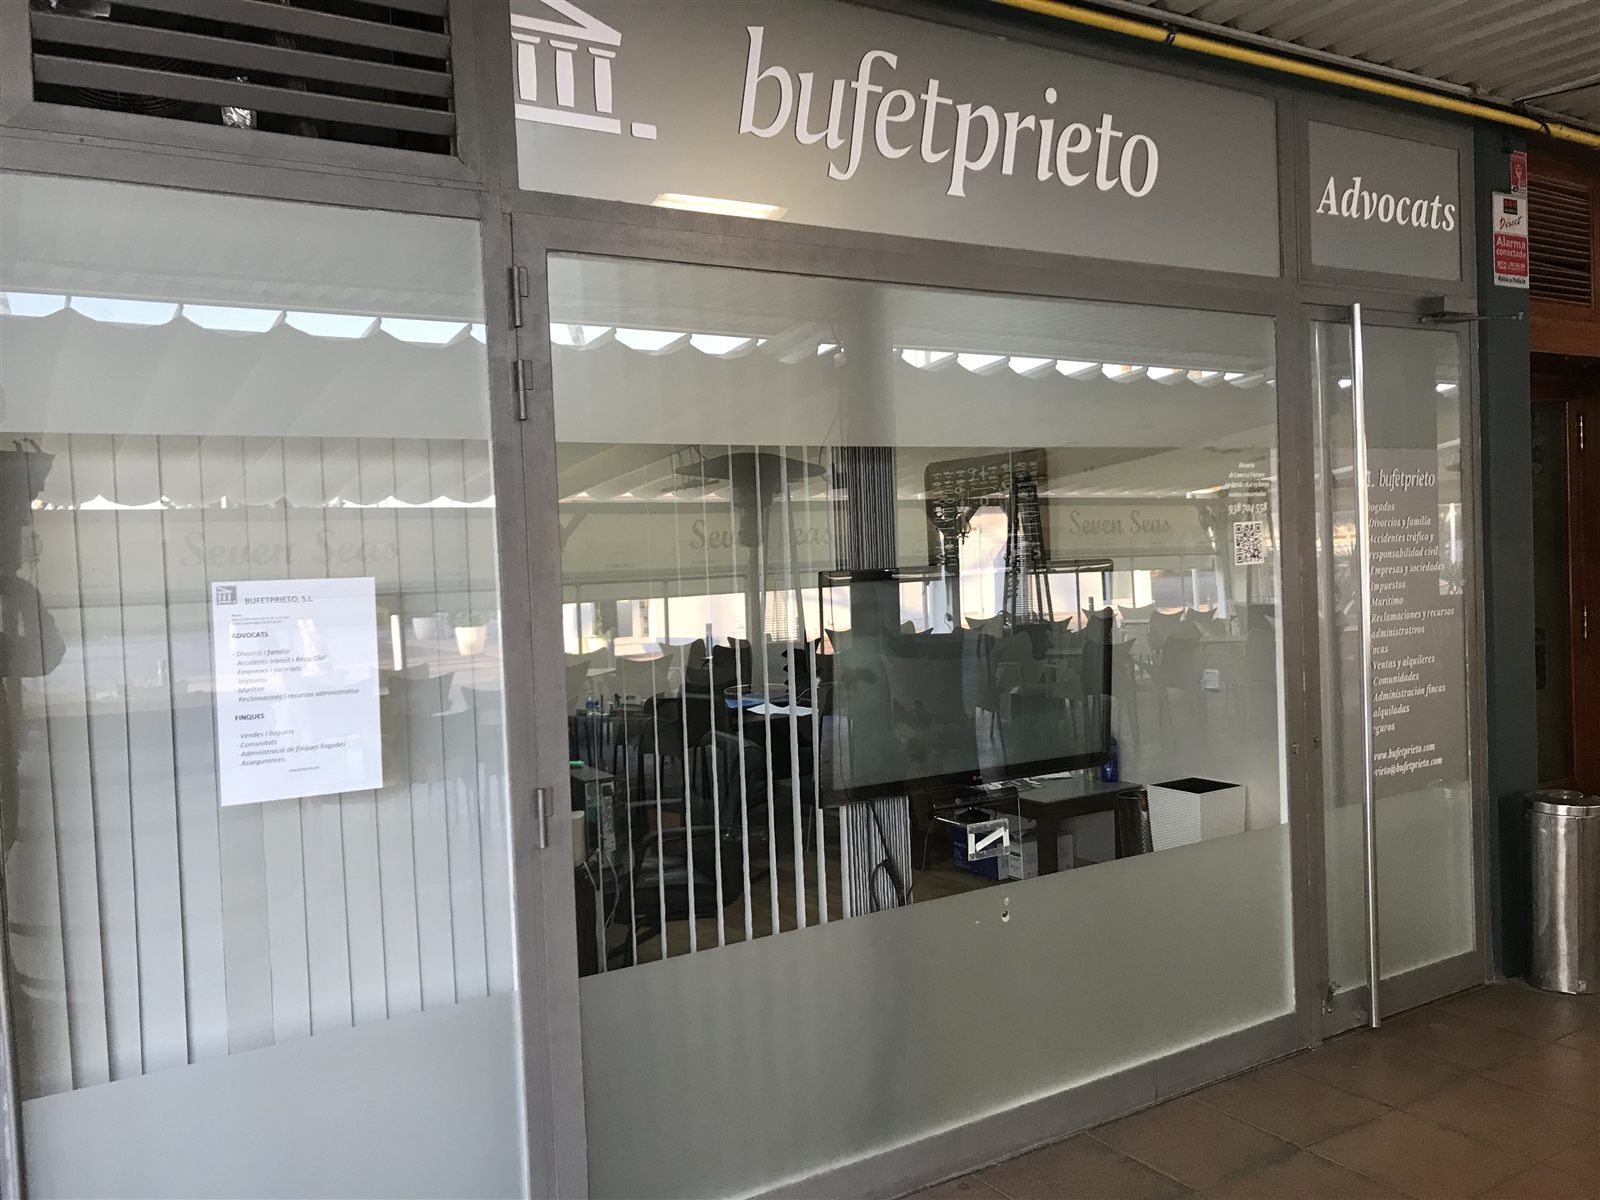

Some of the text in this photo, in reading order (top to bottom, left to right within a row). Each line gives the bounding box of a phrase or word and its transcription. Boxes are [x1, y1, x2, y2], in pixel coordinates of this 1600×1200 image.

[739, 26, 1158, 197] bufetprieto
[1316, 176, 1456, 232] Advocats
[1496, 236, 1526, 249] Alarma
[1379, 468, 1435, 491] bufetprieto
[1070, 510, 1172, 536] Seven Seas
[1370, 564, 1404, 578] Empresas
[1370, 580, 1406, 593] Impuestos
[232, 631, 269, 640] ADVOCATS
[1373, 672, 1420, 686] Comunidades
[235, 712, 265, 721] FINQUES
[1373, 703, 1410, 720] alquiladas
